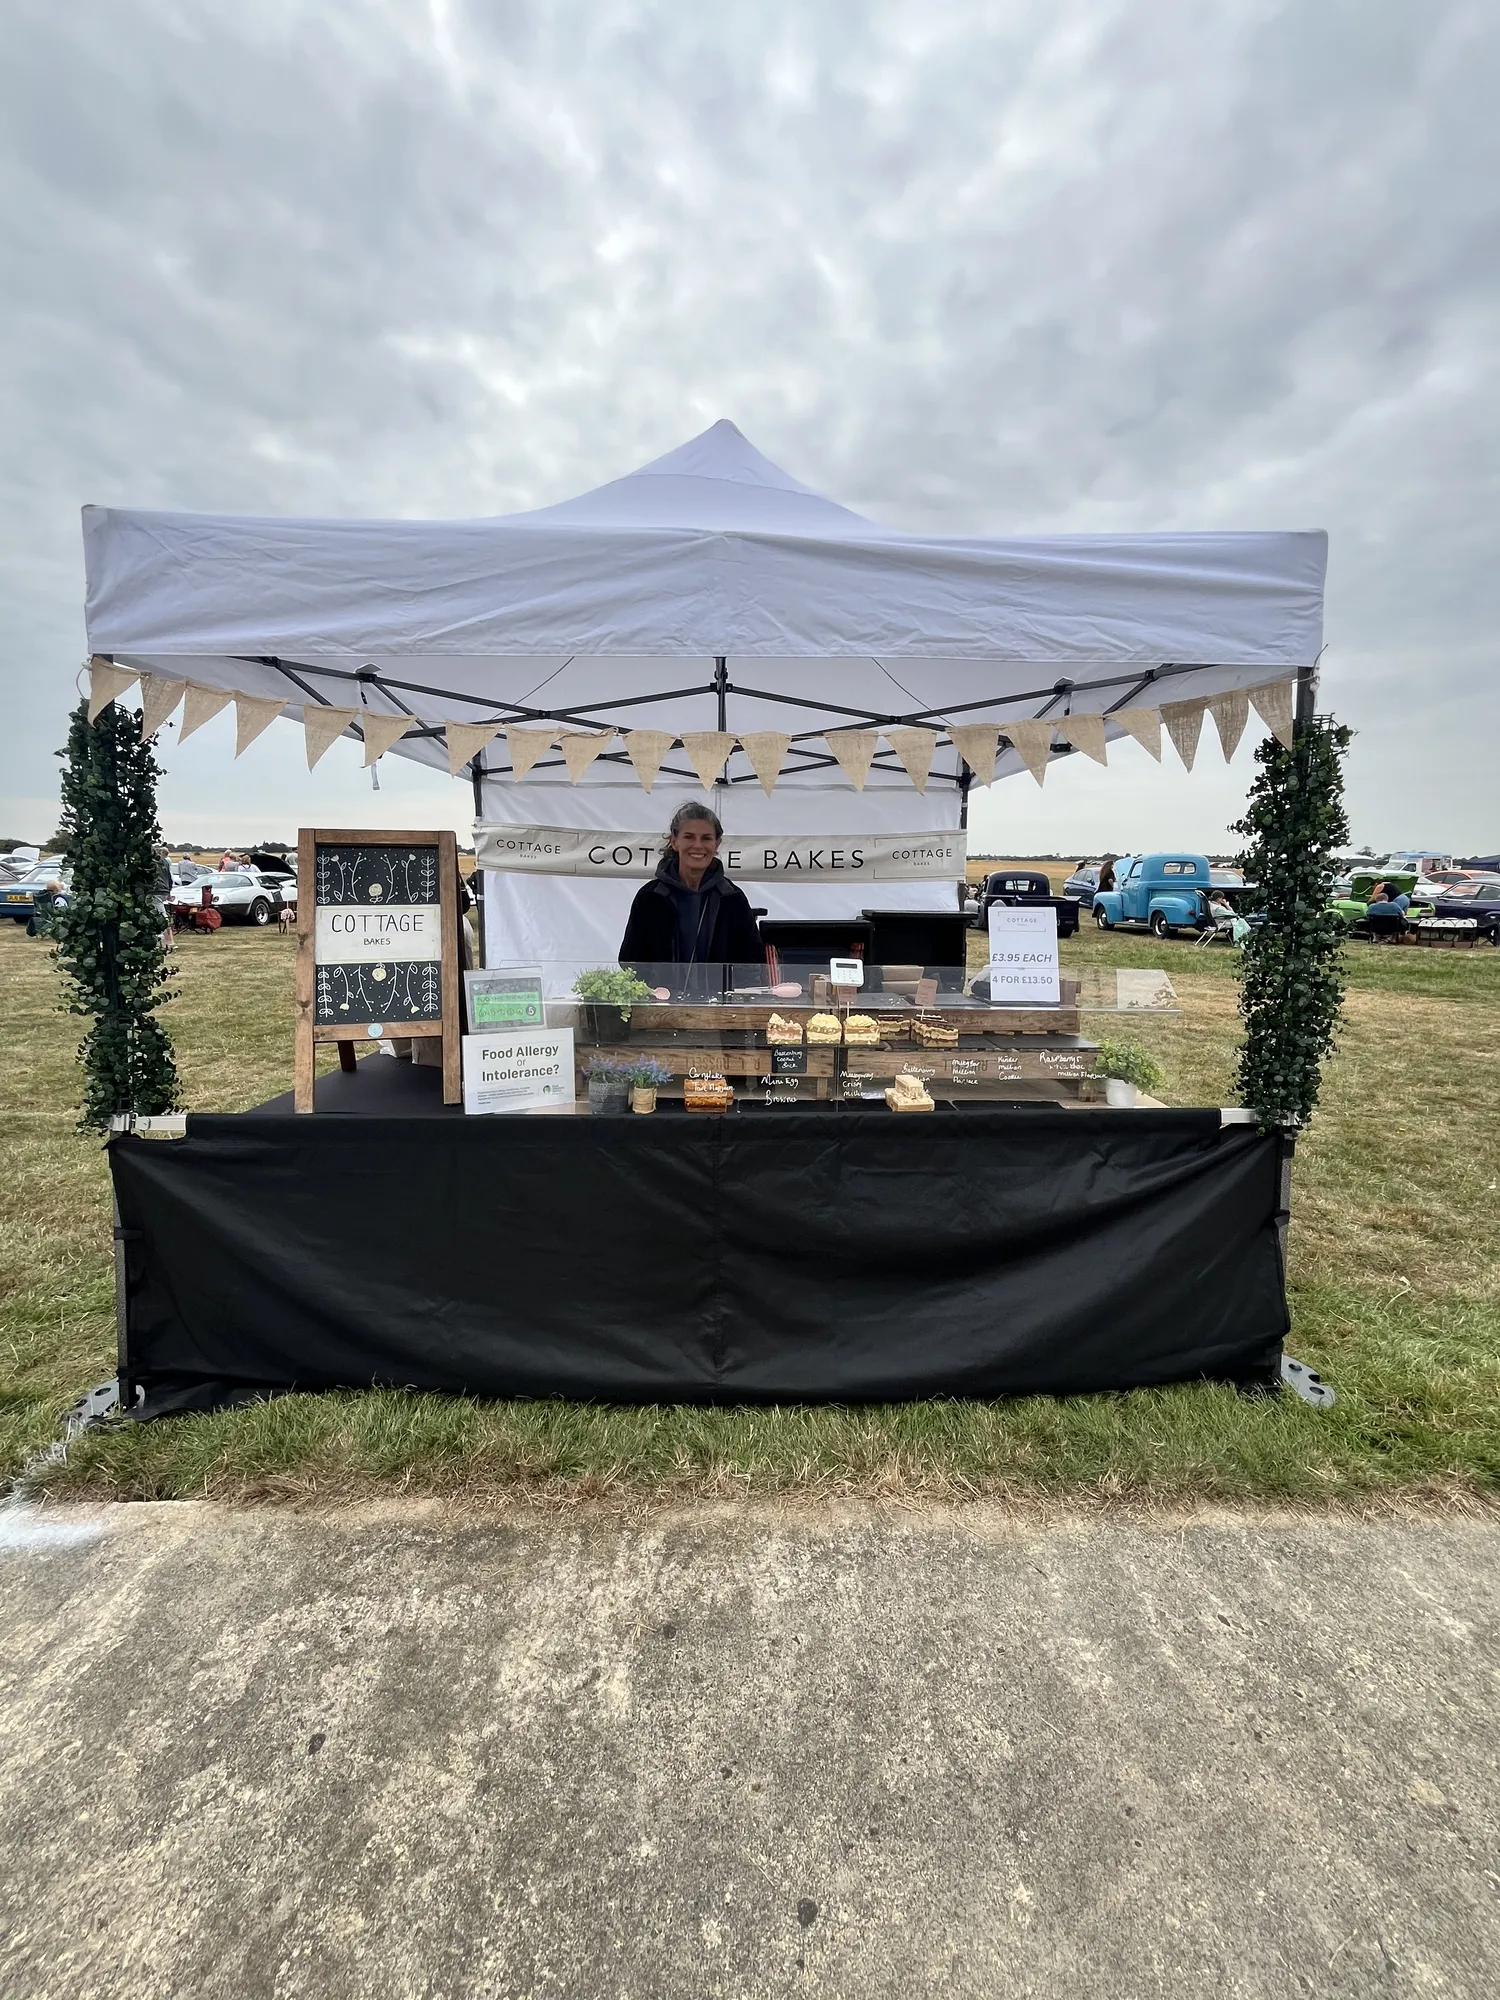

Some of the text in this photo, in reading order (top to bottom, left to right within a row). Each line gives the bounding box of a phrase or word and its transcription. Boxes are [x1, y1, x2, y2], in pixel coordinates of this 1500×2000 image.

[496, 839, 561, 855] COTTAGE
[588, 845, 865, 870] COTE BAKES
[892, 848, 953, 860] COTTAGE
[331, 914, 424, 933] COTTAGE
[363, 938, 391, 946] BAKES
[991, 953, 1052, 963] £3.95 EACH
[991, 976, 1053, 985] 4 FOR £13.50
[482, 1045, 559, 1060] Food Allergy
[516, 1059, 527, 1067] or
[482, 1064, 560, 1082] Intolerance?
[785, 1077, 799, 1090] Egg
